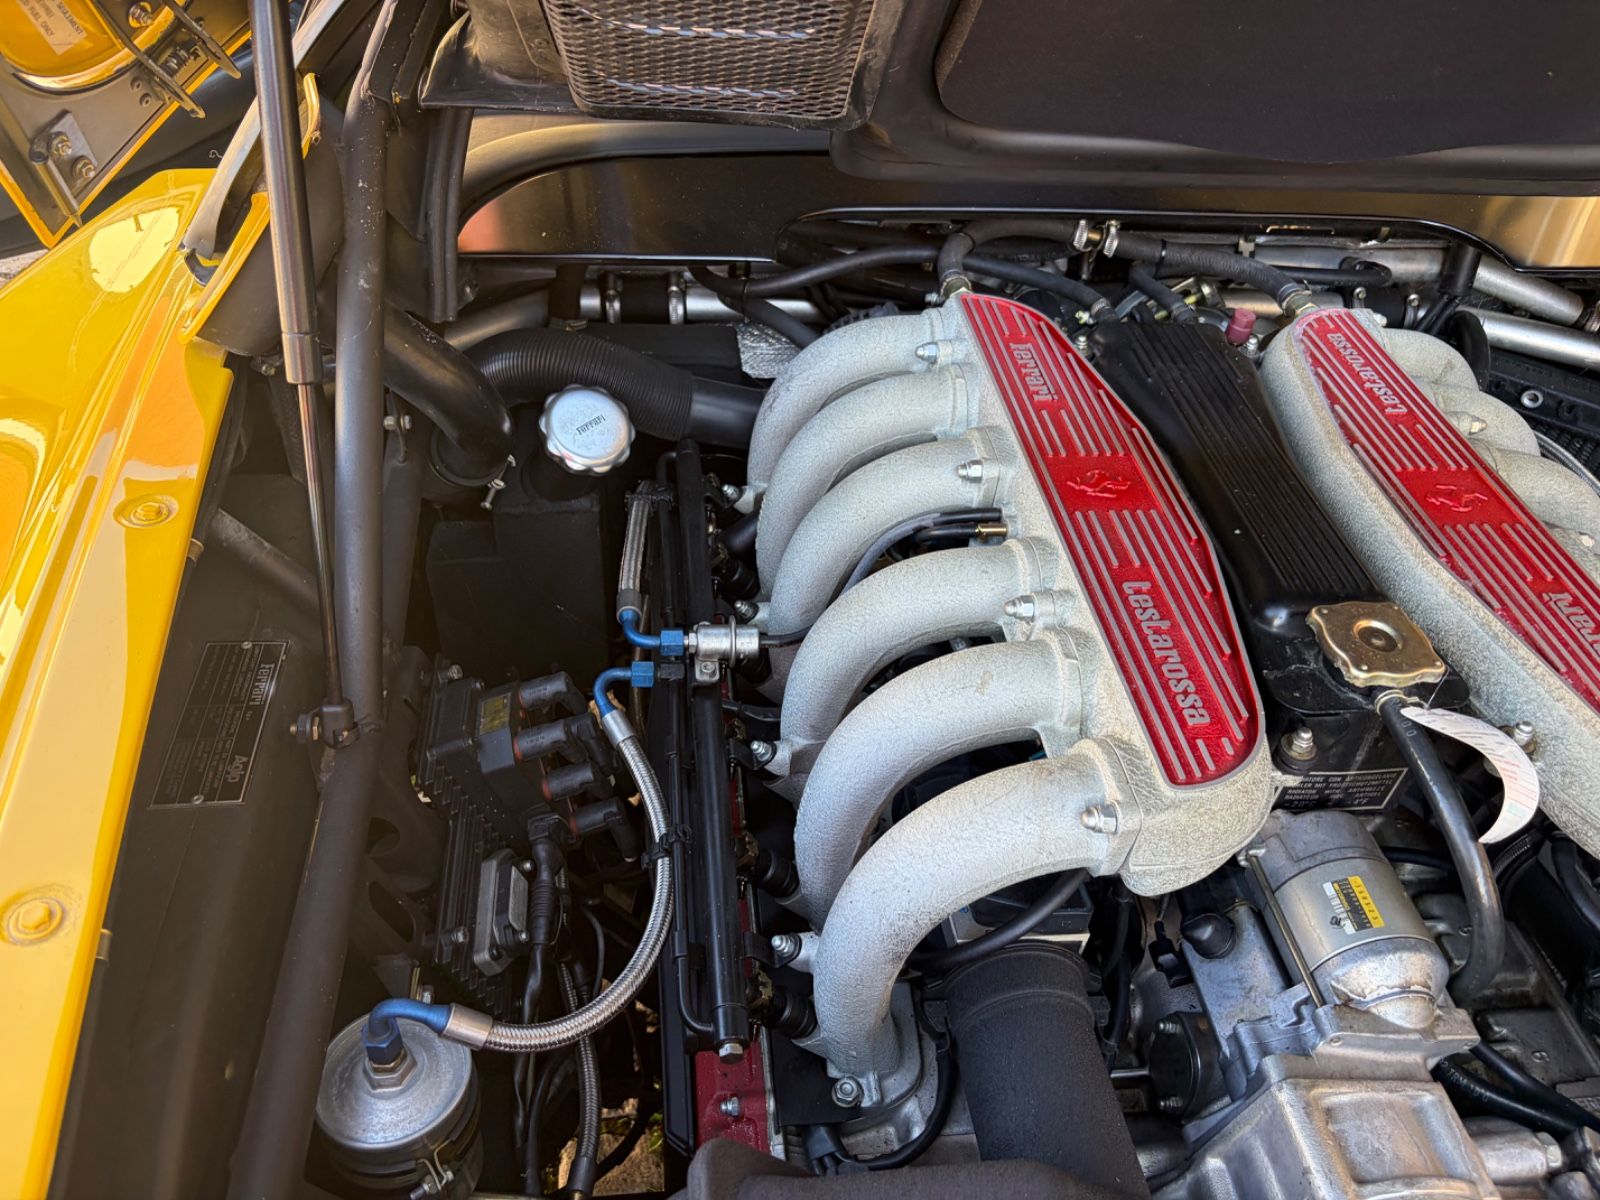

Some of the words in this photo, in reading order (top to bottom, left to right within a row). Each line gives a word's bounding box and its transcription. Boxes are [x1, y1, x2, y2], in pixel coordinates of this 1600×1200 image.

[1009, 342, 1059, 401] Ferrari
[1327, 332, 1409, 413] testarossa
[1122, 581, 1211, 727] testarossa
[249, 662, 275, 706] Ferrari
[226, 754, 249, 784] Agip
